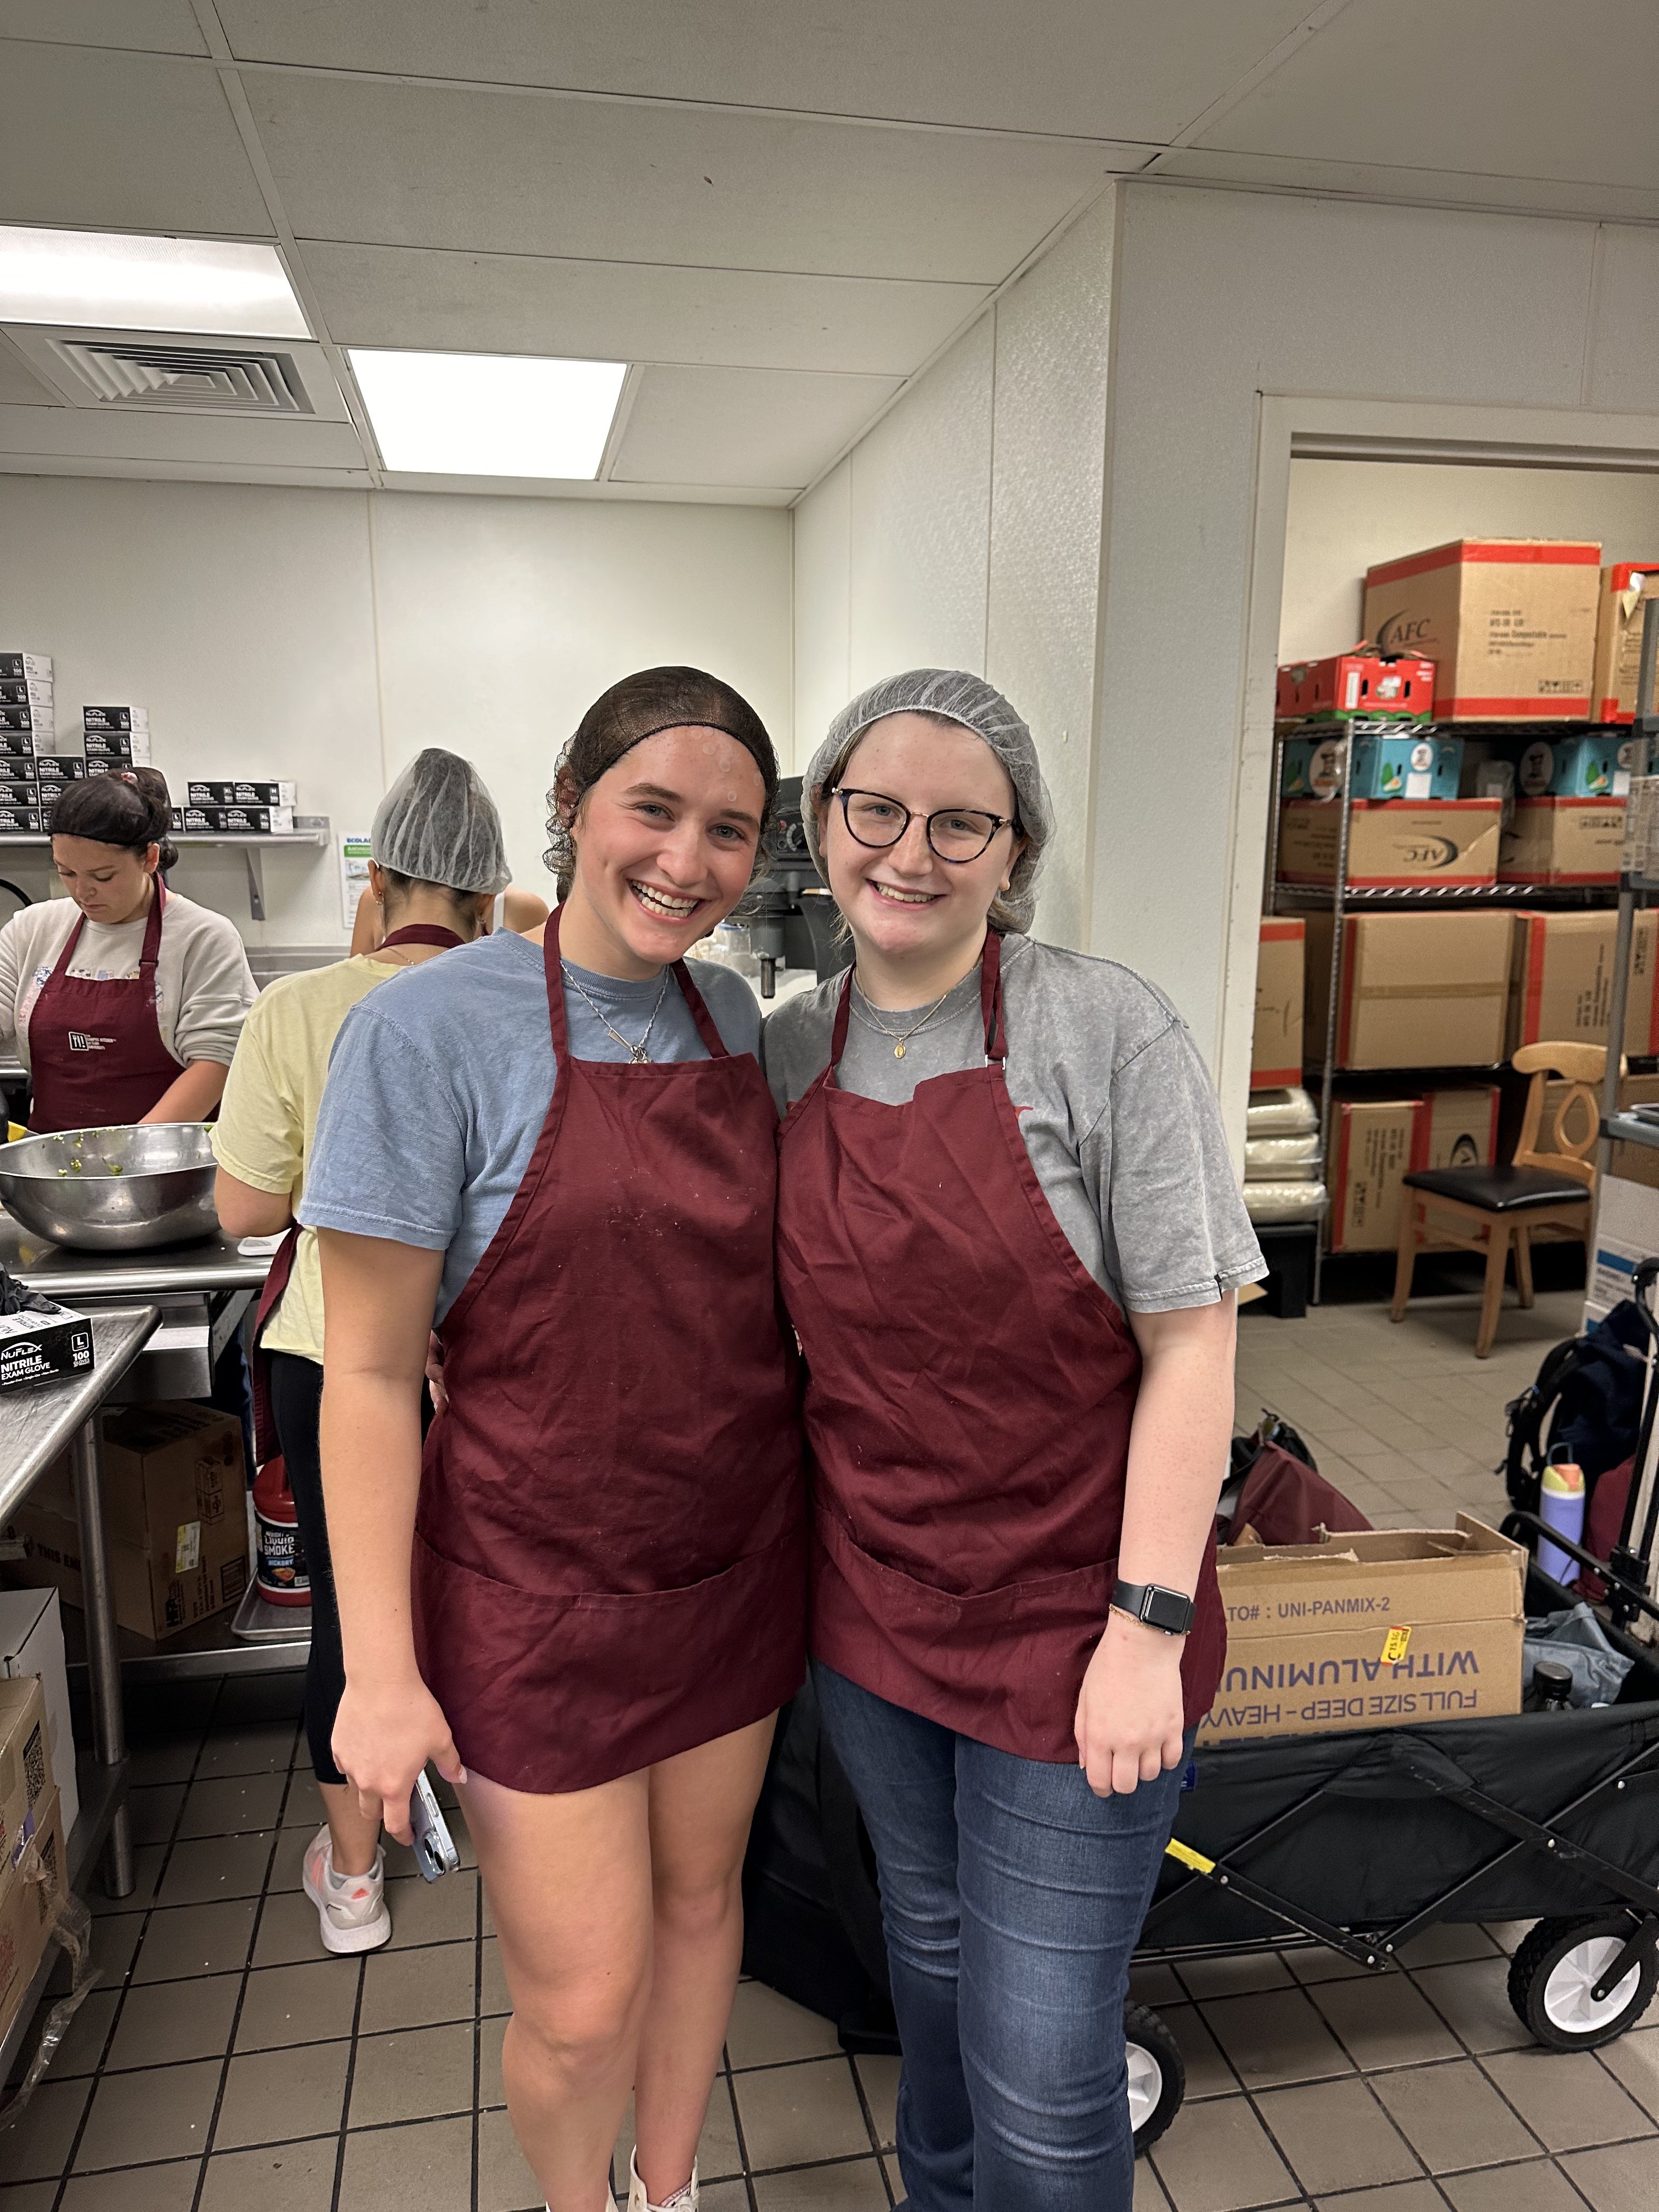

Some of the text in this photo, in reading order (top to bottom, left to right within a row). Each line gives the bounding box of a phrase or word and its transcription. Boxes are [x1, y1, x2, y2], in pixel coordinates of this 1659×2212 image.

[1390, 617, 1430, 644] AFC
[77, 1336, 84, 1346] L
[1, 1355, 42, 1374] NITRILE
[72, 1350, 90, 1361] 100
[1, 1362, 51, 1380] EXAM GLOVE
[264, 1536, 295, 1545] LIQUID
[264, 1543, 295, 1556] SMOKE
[37, 1543, 61, 1564] THIS
[1277, 1596, 1391, 1619] UNI-PANMIX-2
[1216, 1650, 1480, 1693] WITH ALUMINU
[1301, 1697, 1364, 1721] DEEP
[1368, 1693, 1417, 1716] SIZE
[1420, 1688, 1477, 1711] FULL
